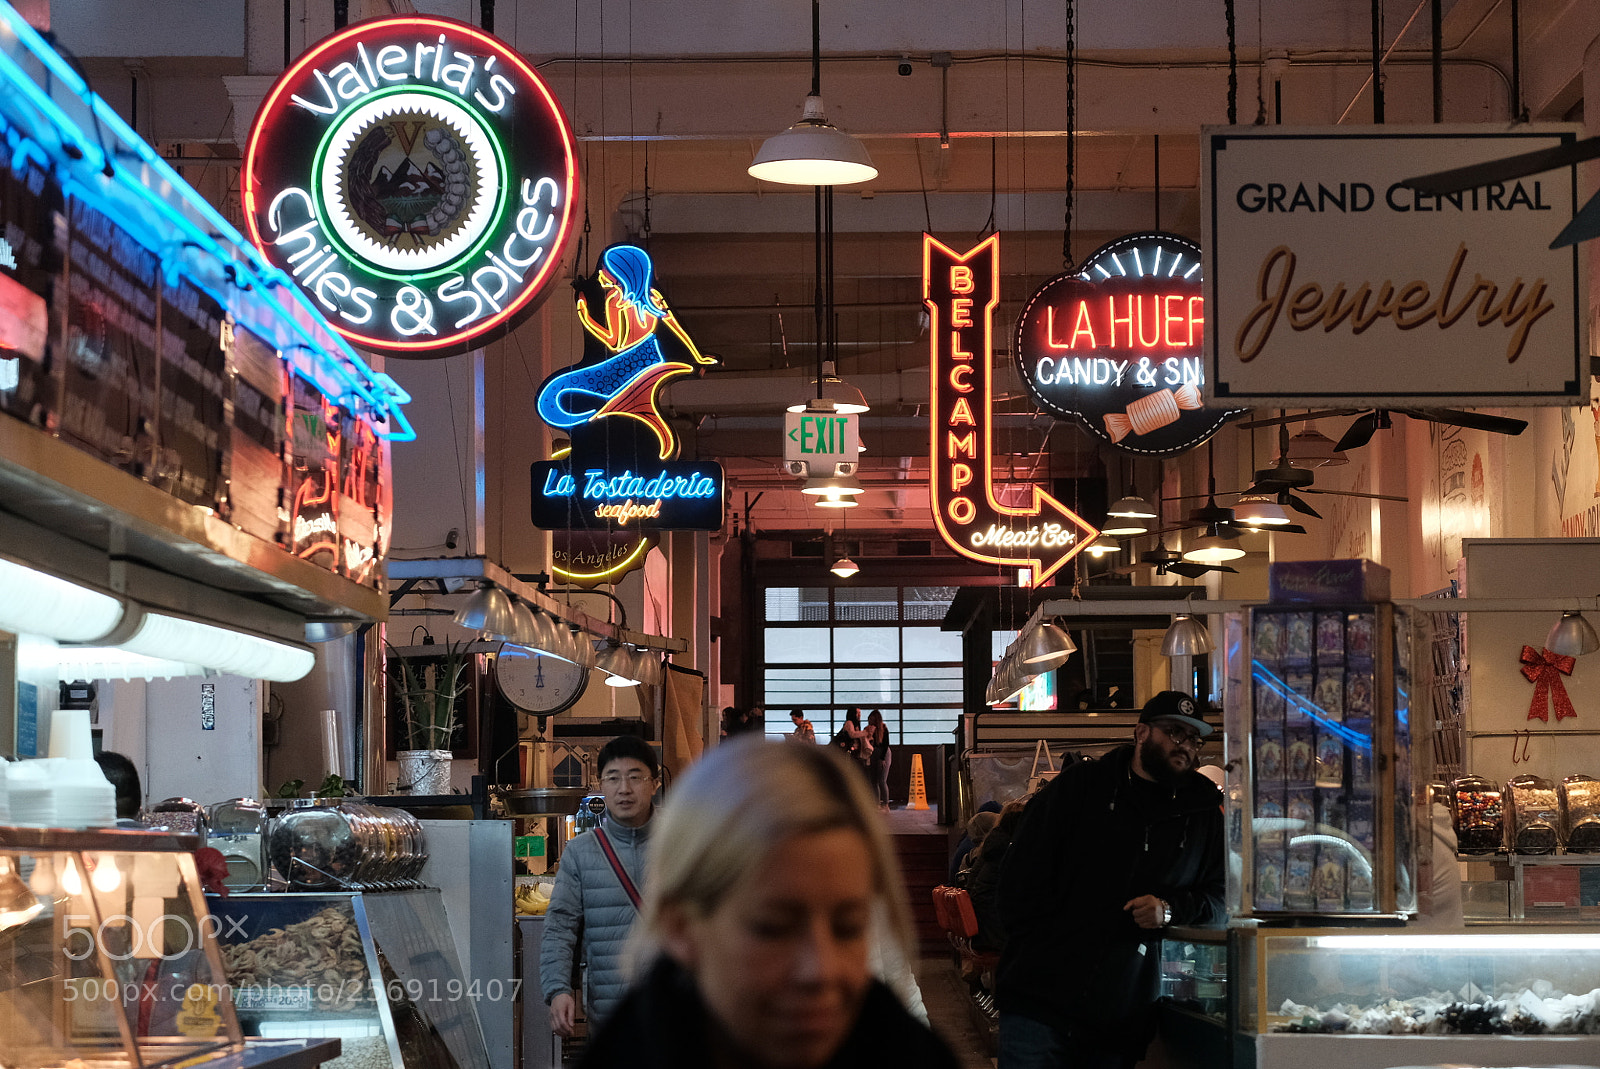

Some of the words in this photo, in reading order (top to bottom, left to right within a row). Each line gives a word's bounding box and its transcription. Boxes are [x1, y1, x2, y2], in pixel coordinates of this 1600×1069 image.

[290, 33, 516, 116] Valeria's
[1236, 182, 1374, 213] GRAND
[268, 186, 377, 325] Chiles
[390, 287, 437, 336] &
[437, 176, 560, 328] Spices
[1233, 241, 1554, 363] Jewelry
[1046, 299, 1097, 349] LA
[1036, 355, 1129, 387] CANDY
[1136, 356, 1159, 387] &
[1163, 356, 1206, 387] SN
[948, 265, 977, 525] BELCAMPO
[803, 417, 850, 454] EXIT
[542, 467, 575, 496] La
[593, 498, 661, 525] seafood
[970, 523, 1037, 548] Meat
[553, 549, 568, 562] os
[572, 542, 629, 569] Angeles
